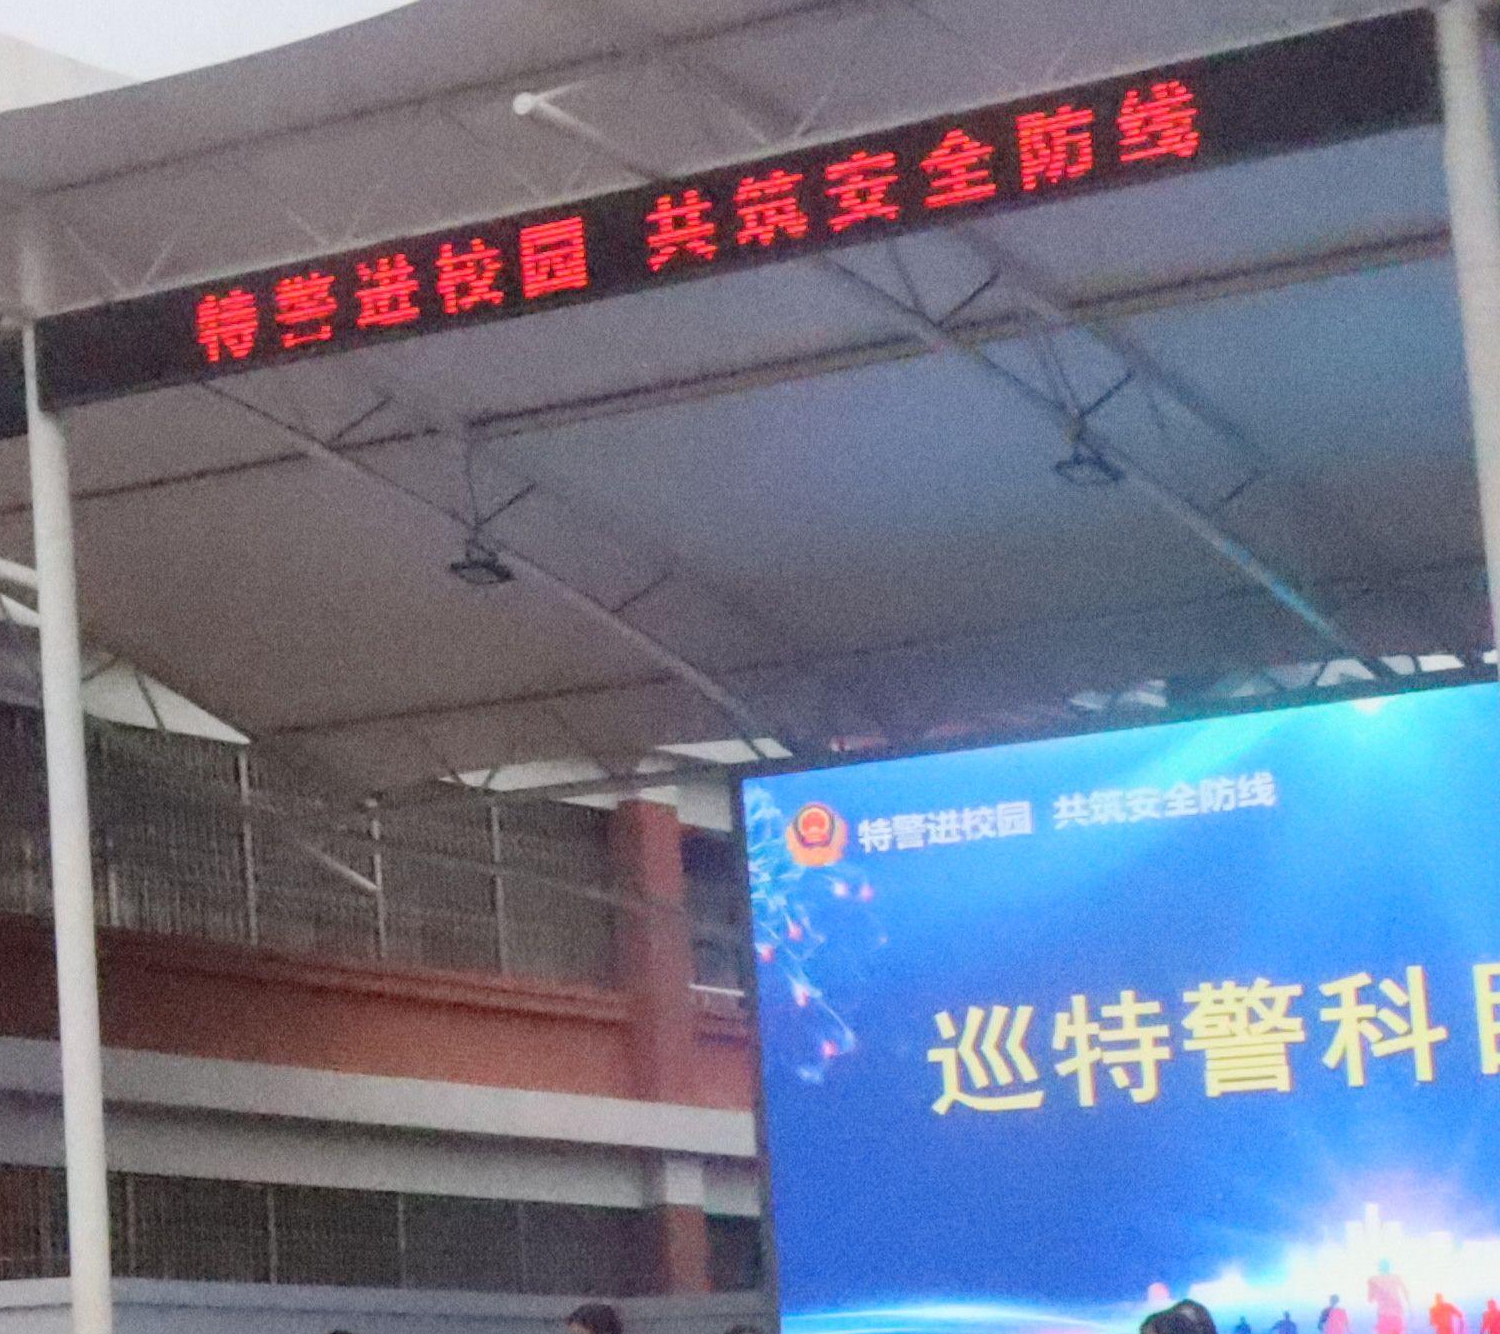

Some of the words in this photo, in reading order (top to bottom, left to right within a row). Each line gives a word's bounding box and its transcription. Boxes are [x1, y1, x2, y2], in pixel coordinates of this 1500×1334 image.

[197, 217, 589, 363] 特警进校园
[646, 81, 1199, 271] 共筑安全防线
[857, 800, 1033, 853] 特警进校园
[1053, 771, 1276, 830] 共筑安全防线
